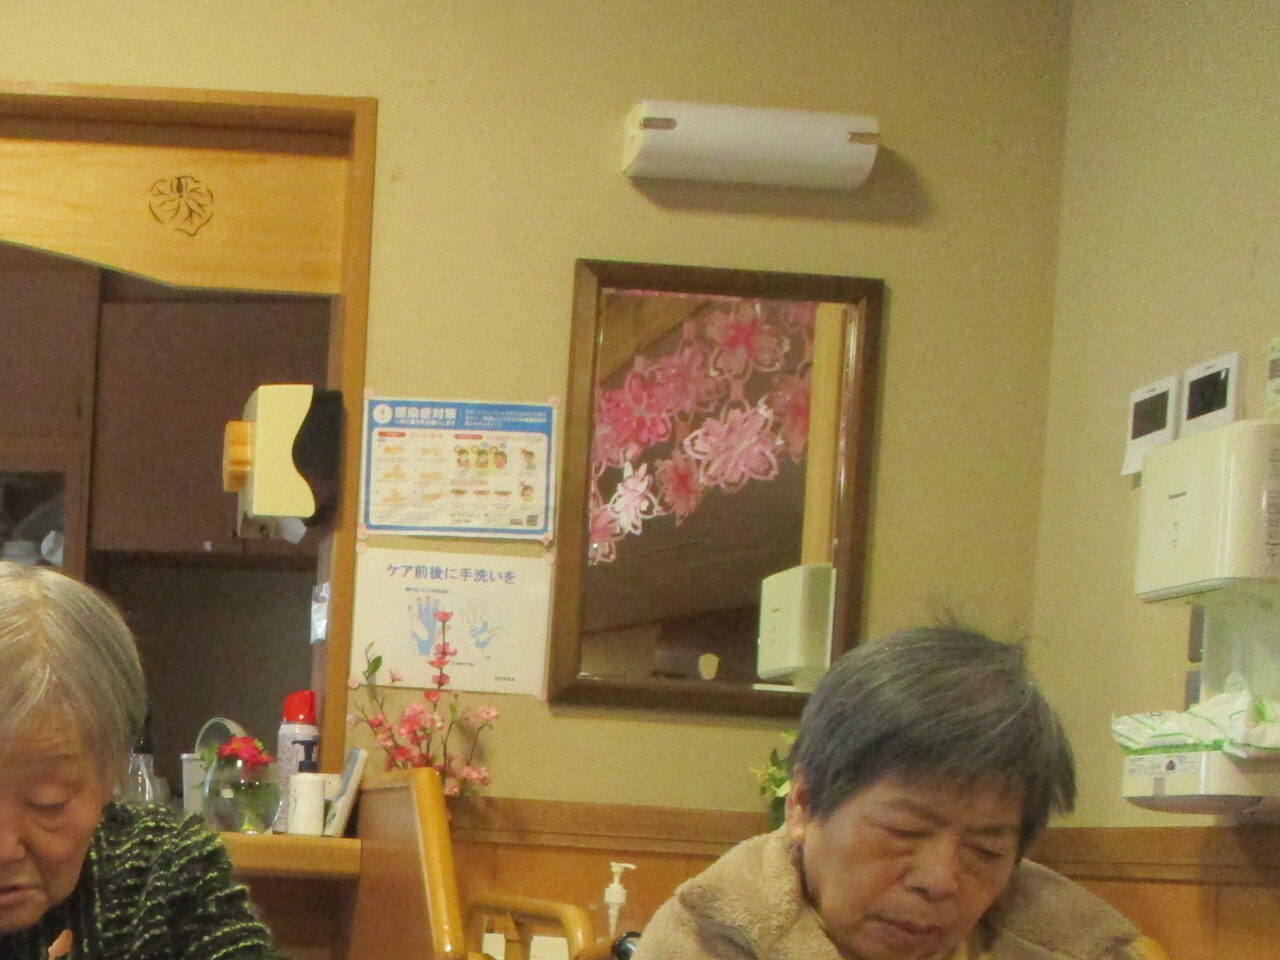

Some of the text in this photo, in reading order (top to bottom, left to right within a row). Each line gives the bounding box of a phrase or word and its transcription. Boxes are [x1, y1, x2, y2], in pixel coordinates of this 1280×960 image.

[387, 563, 517, 584] ケア前後に手洗いを
